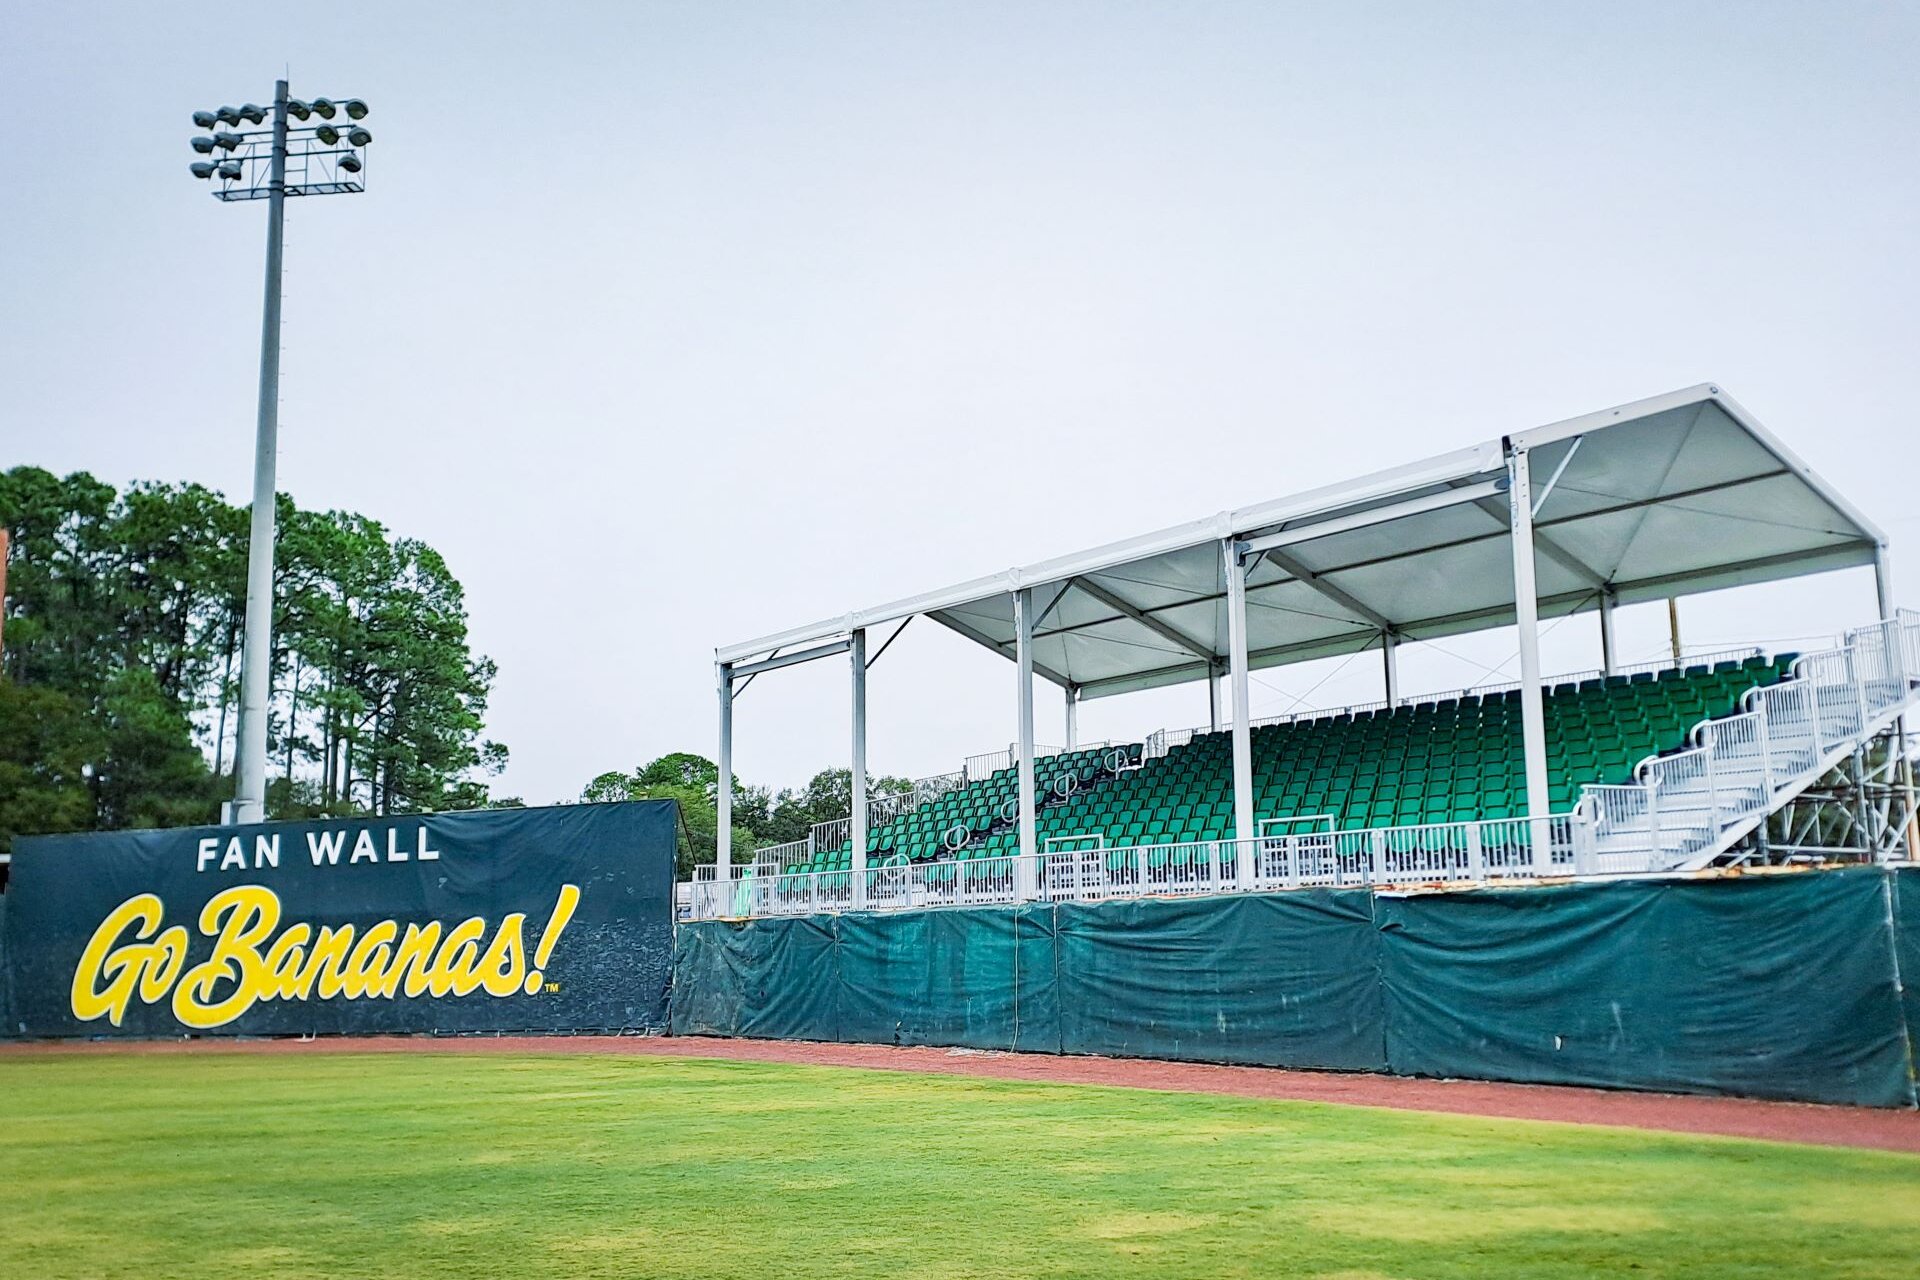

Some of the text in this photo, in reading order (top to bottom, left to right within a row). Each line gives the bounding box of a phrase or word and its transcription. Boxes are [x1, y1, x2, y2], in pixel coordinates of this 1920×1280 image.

[197, 826, 439, 871] FAN WALL
[71, 885, 580, 1028] Go Bananas!
